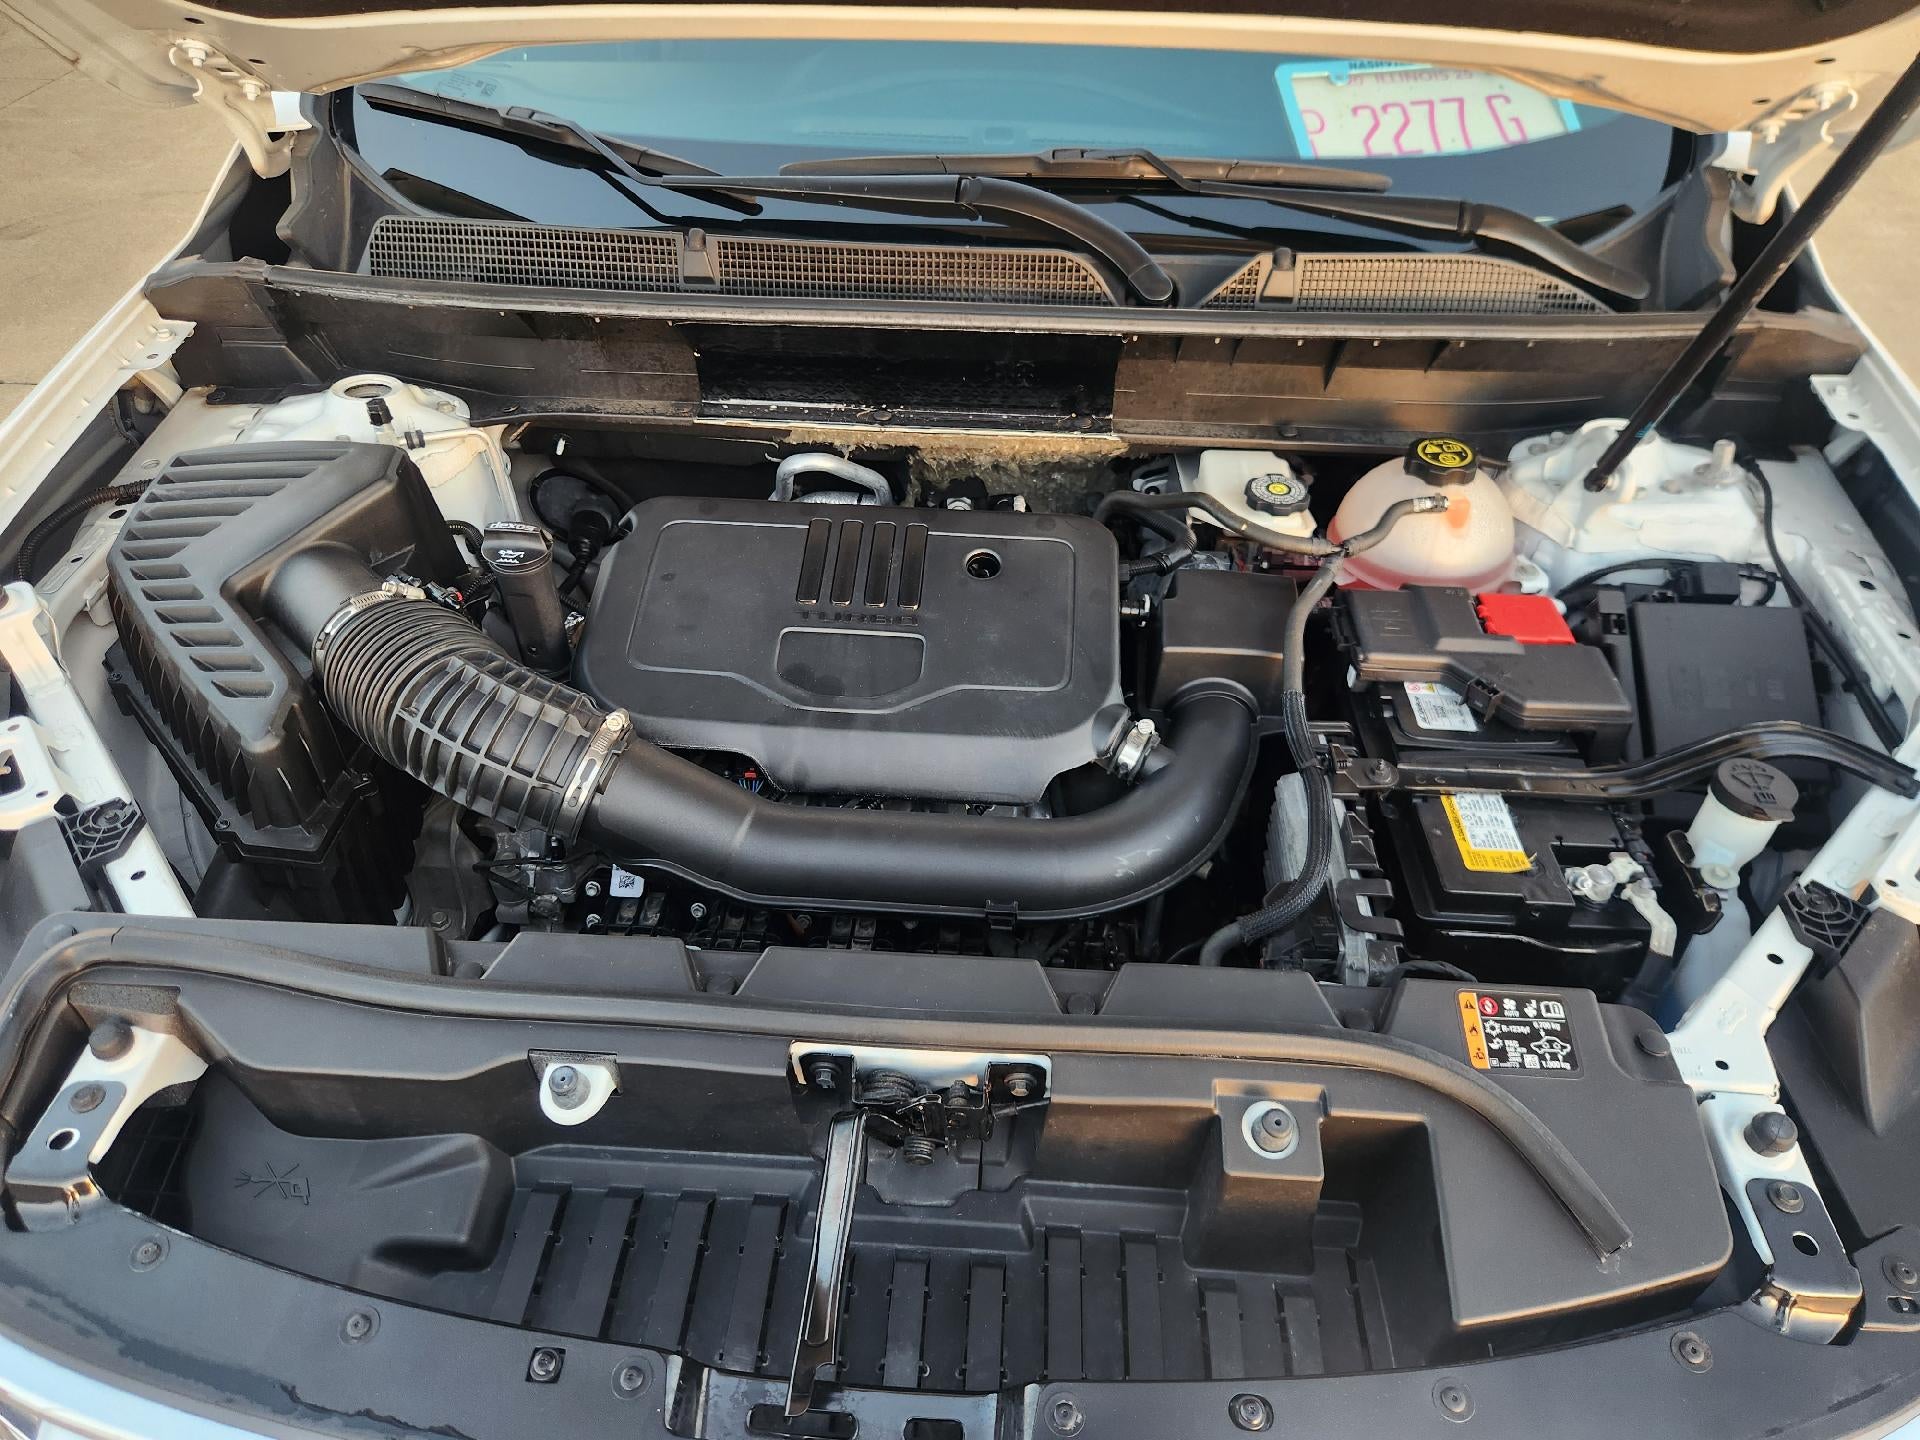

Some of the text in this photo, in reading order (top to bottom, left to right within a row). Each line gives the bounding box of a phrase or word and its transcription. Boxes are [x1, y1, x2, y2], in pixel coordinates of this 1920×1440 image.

[1375, 70, 1448, 84] ILLINOIS
[1351, 97, 1472, 157] 2277
[1485, 94, 1528, 145] G
[490, 522, 537, 531] dexos
[792, 609, 919, 627] TURBO
